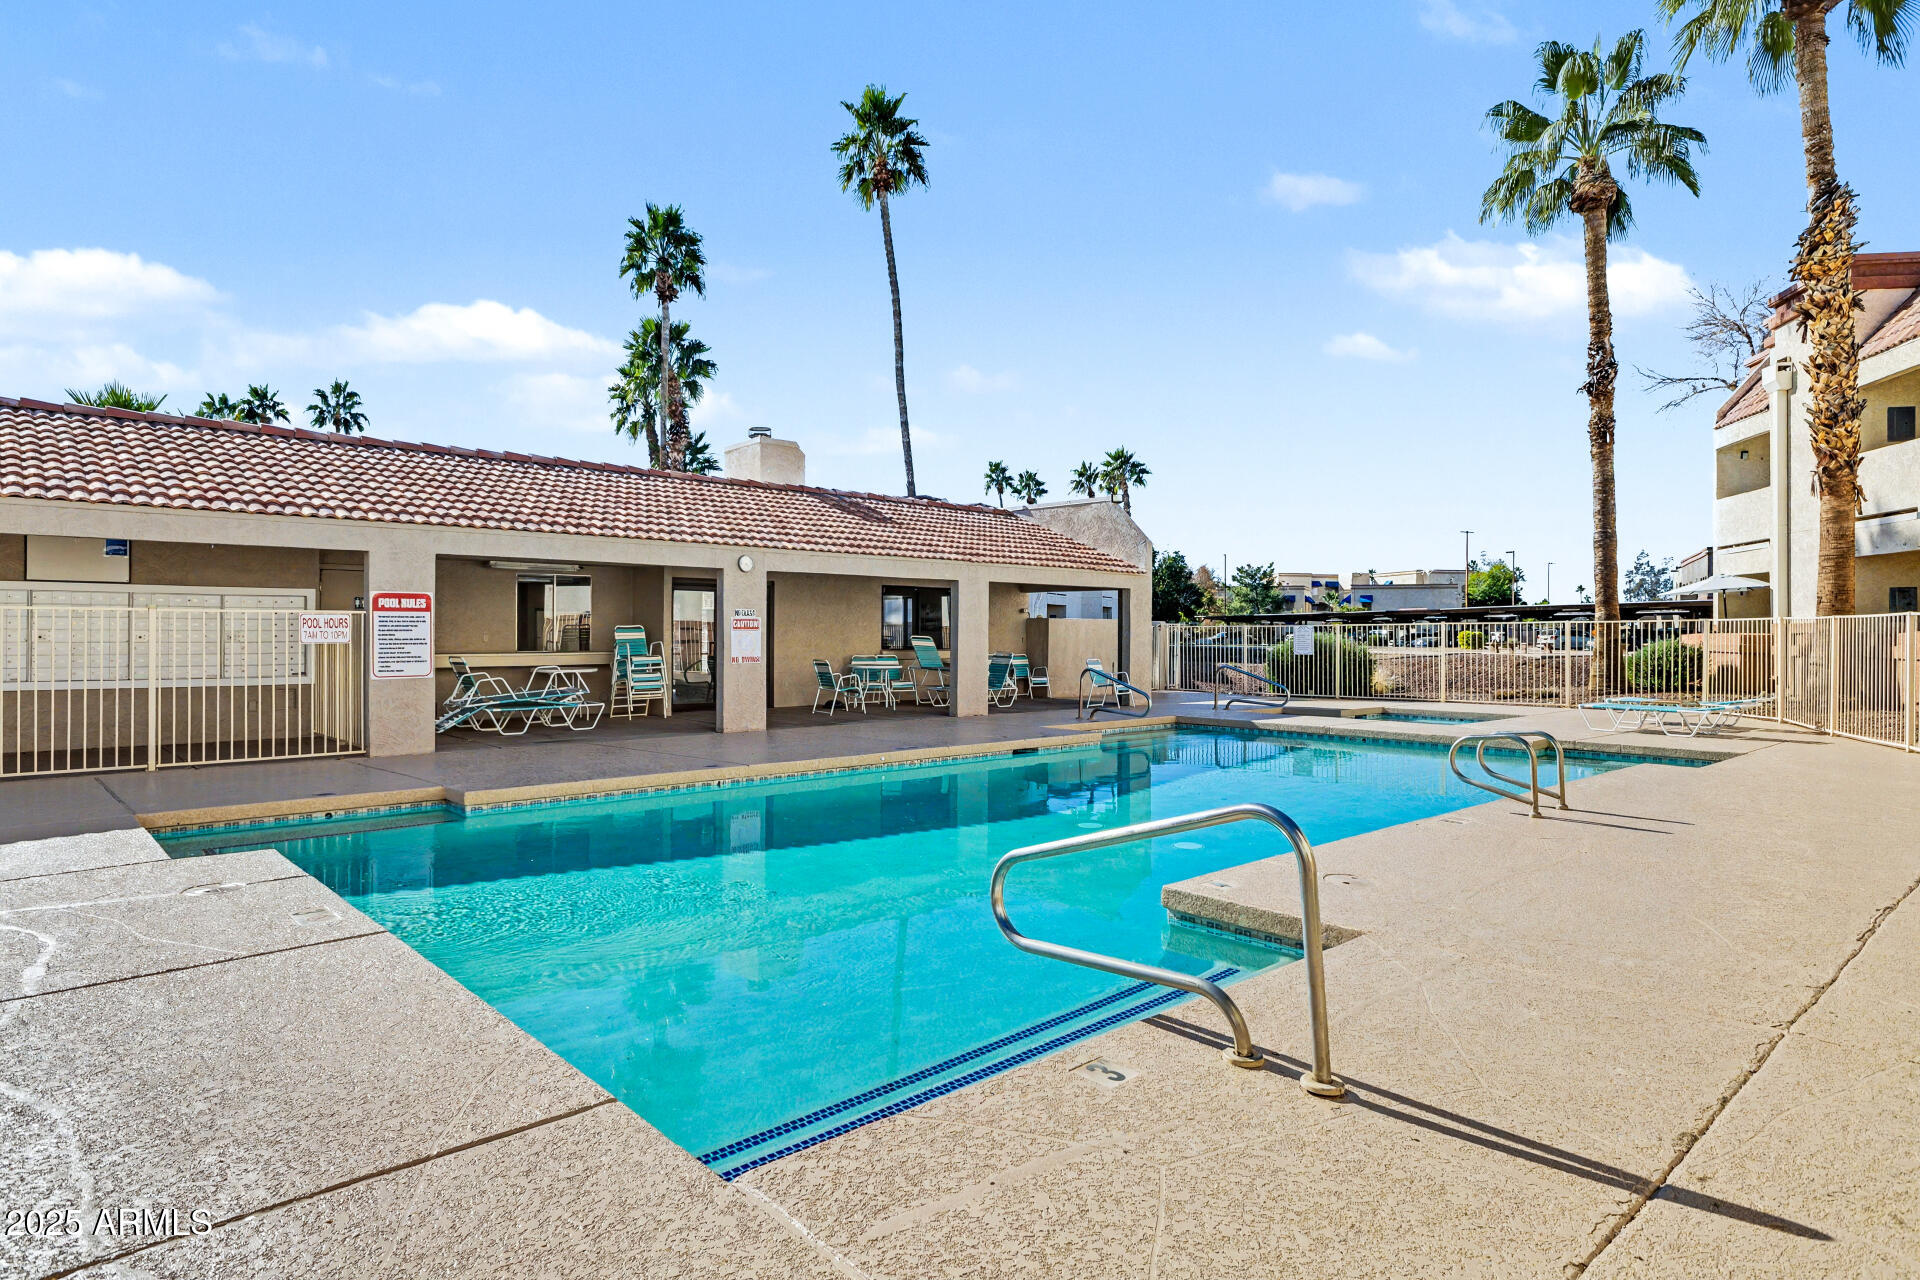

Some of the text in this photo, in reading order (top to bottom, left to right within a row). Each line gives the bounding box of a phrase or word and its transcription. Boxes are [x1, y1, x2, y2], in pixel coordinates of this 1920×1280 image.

[378, 597, 427, 609] POOL RULES
[302, 617, 349, 629] POOL HOURS
[303, 630, 348, 640] 7AM TO 10PM
[731, 656, 740, 664] NO
[1086, 1063, 1126, 1082] 3
